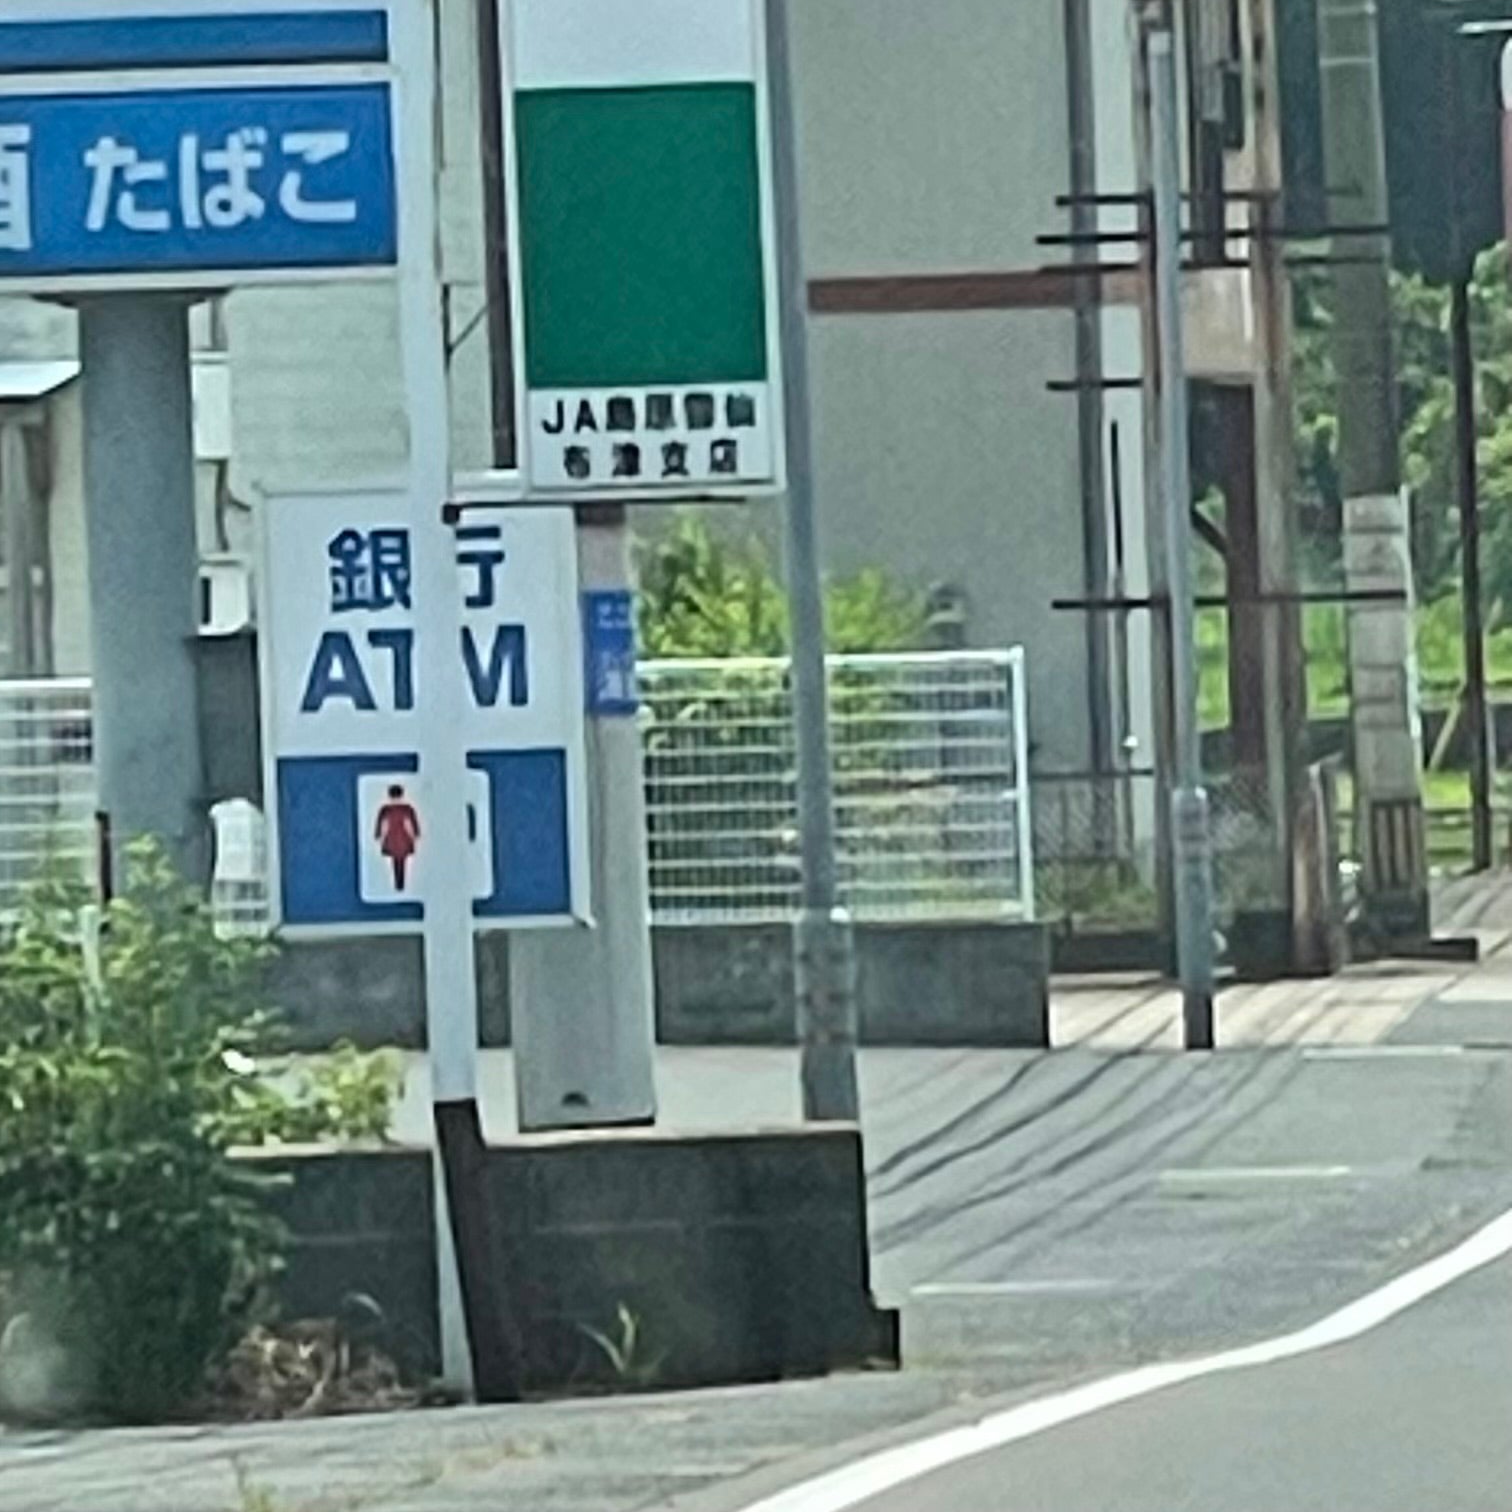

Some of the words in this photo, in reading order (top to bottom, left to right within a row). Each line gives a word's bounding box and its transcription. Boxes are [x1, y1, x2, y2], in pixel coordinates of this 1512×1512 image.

[85, 128, 358, 233] たばこ
[300, 624, 529, 713] ATM
